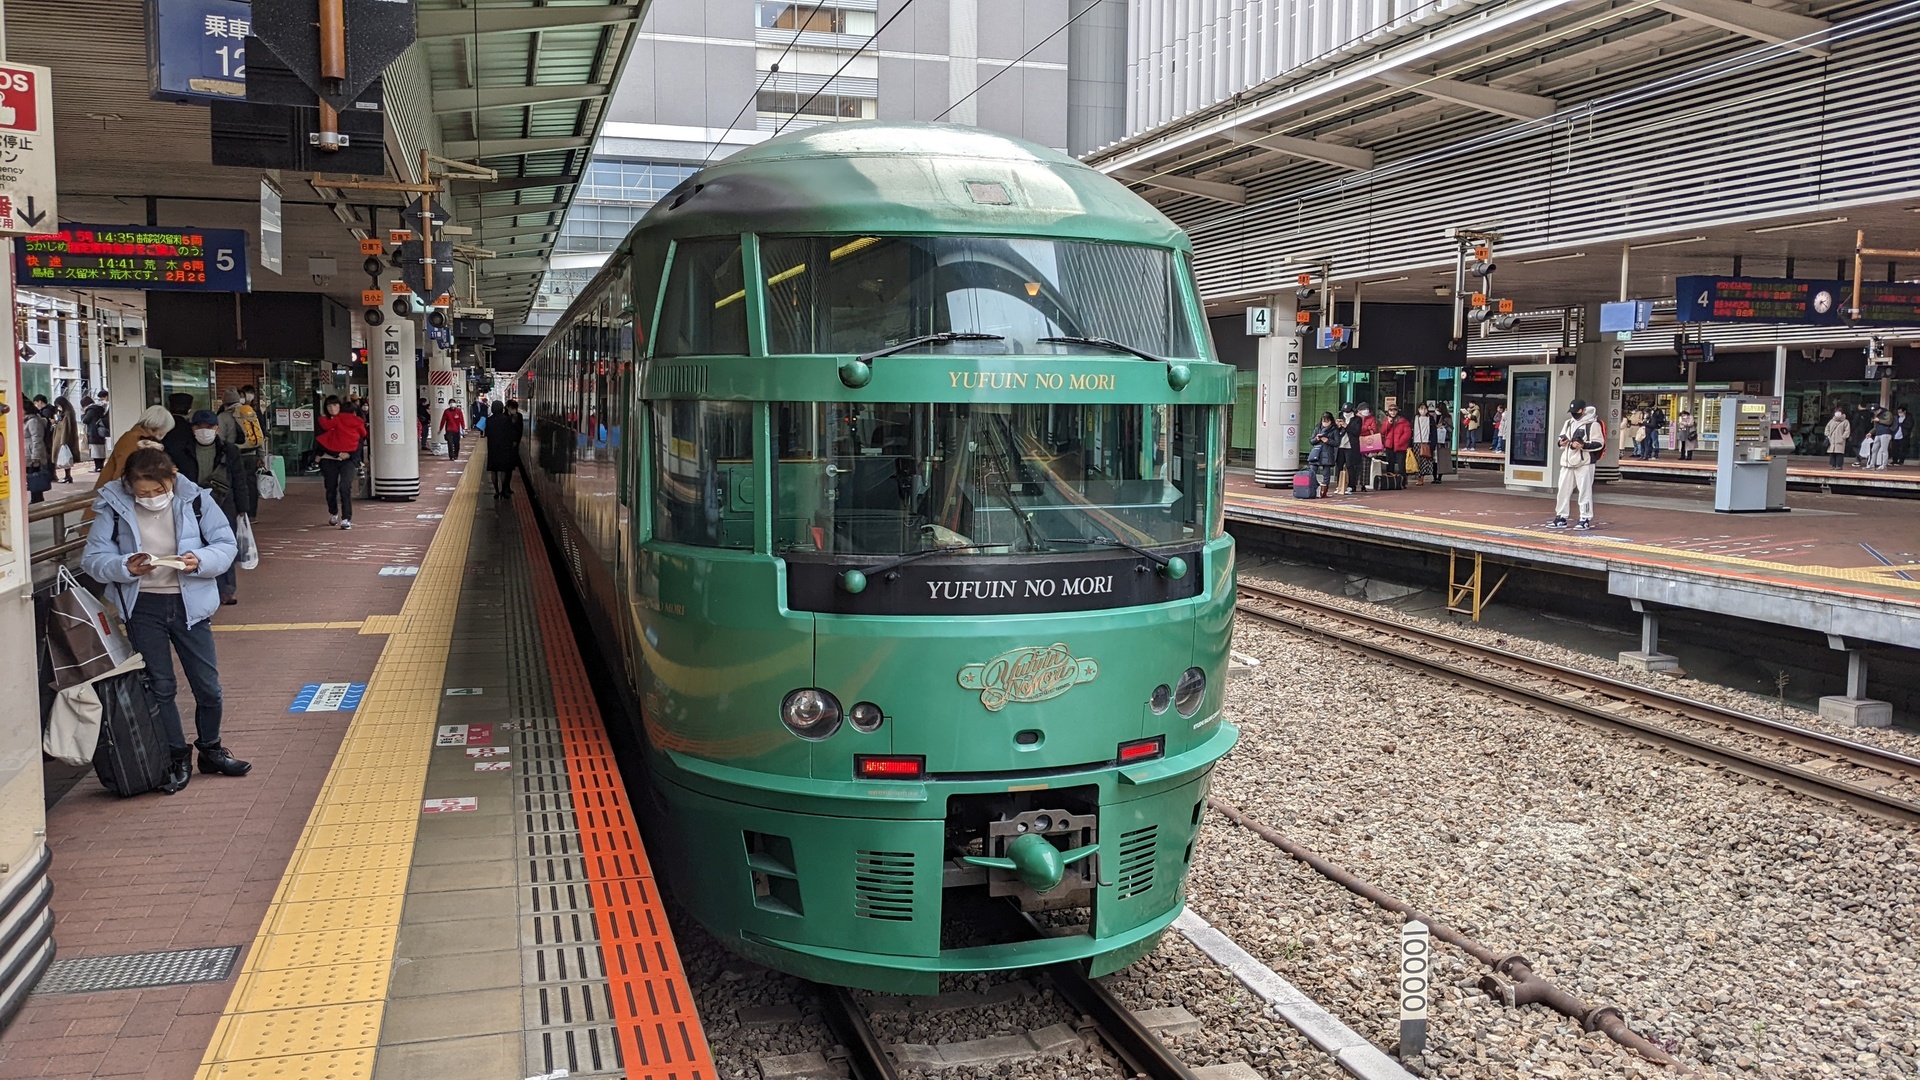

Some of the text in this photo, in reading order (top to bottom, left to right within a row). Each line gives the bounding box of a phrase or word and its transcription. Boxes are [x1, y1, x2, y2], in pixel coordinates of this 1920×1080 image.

[0, 134, 34, 151] 停止
[97, 231, 135, 243] 14:35
[98, 257, 135, 269] 14:41
[216, 249, 235, 272] 5
[1697, 290, 1709, 308] 4
[1256, 309, 1266, 326] 4
[948, 370, 1116, 391] YUFUIN NO MORI
[926, 575, 1114, 600] YUFUIN NO MORI
